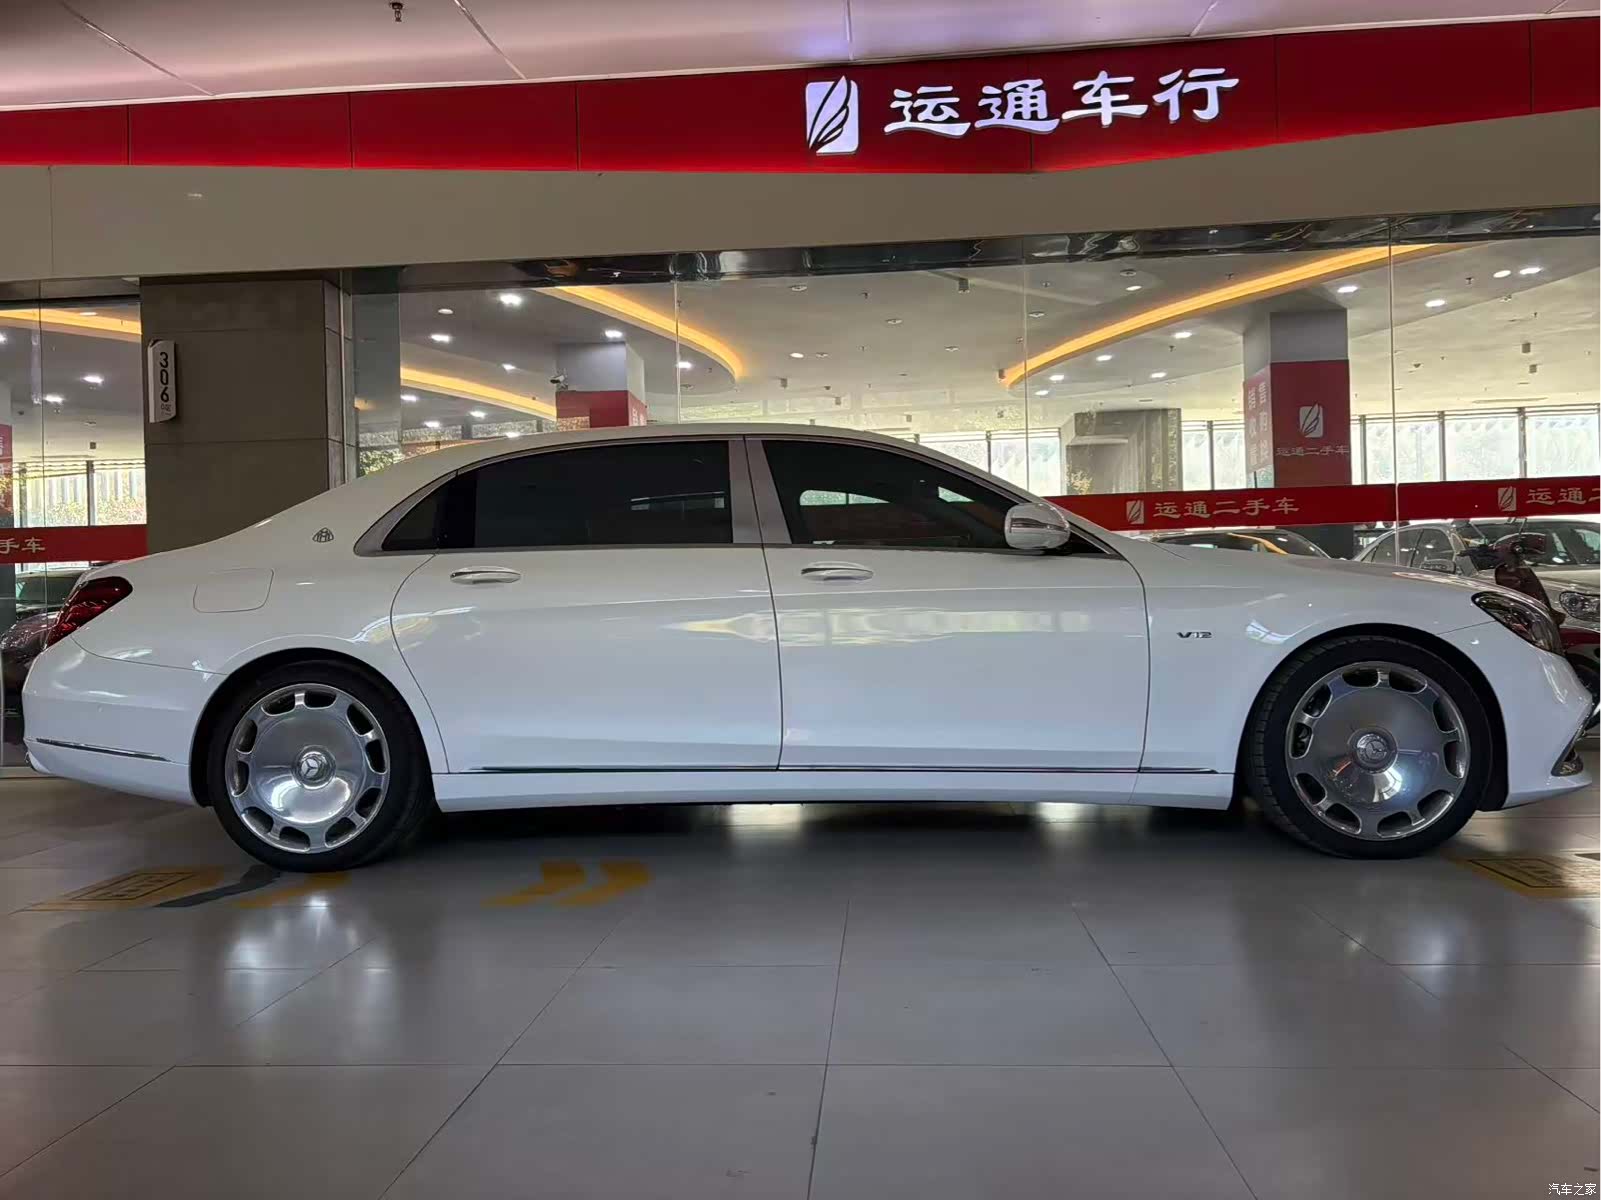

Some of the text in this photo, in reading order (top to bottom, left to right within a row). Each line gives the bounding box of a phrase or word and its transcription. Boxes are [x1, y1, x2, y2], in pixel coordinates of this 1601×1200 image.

[884, 67, 1239, 138] 运通车行
[159, 351, 169, 402] 306
[1153, 497, 1299, 518] 运通二手车
[1176, 631, 1212, 639] V12
